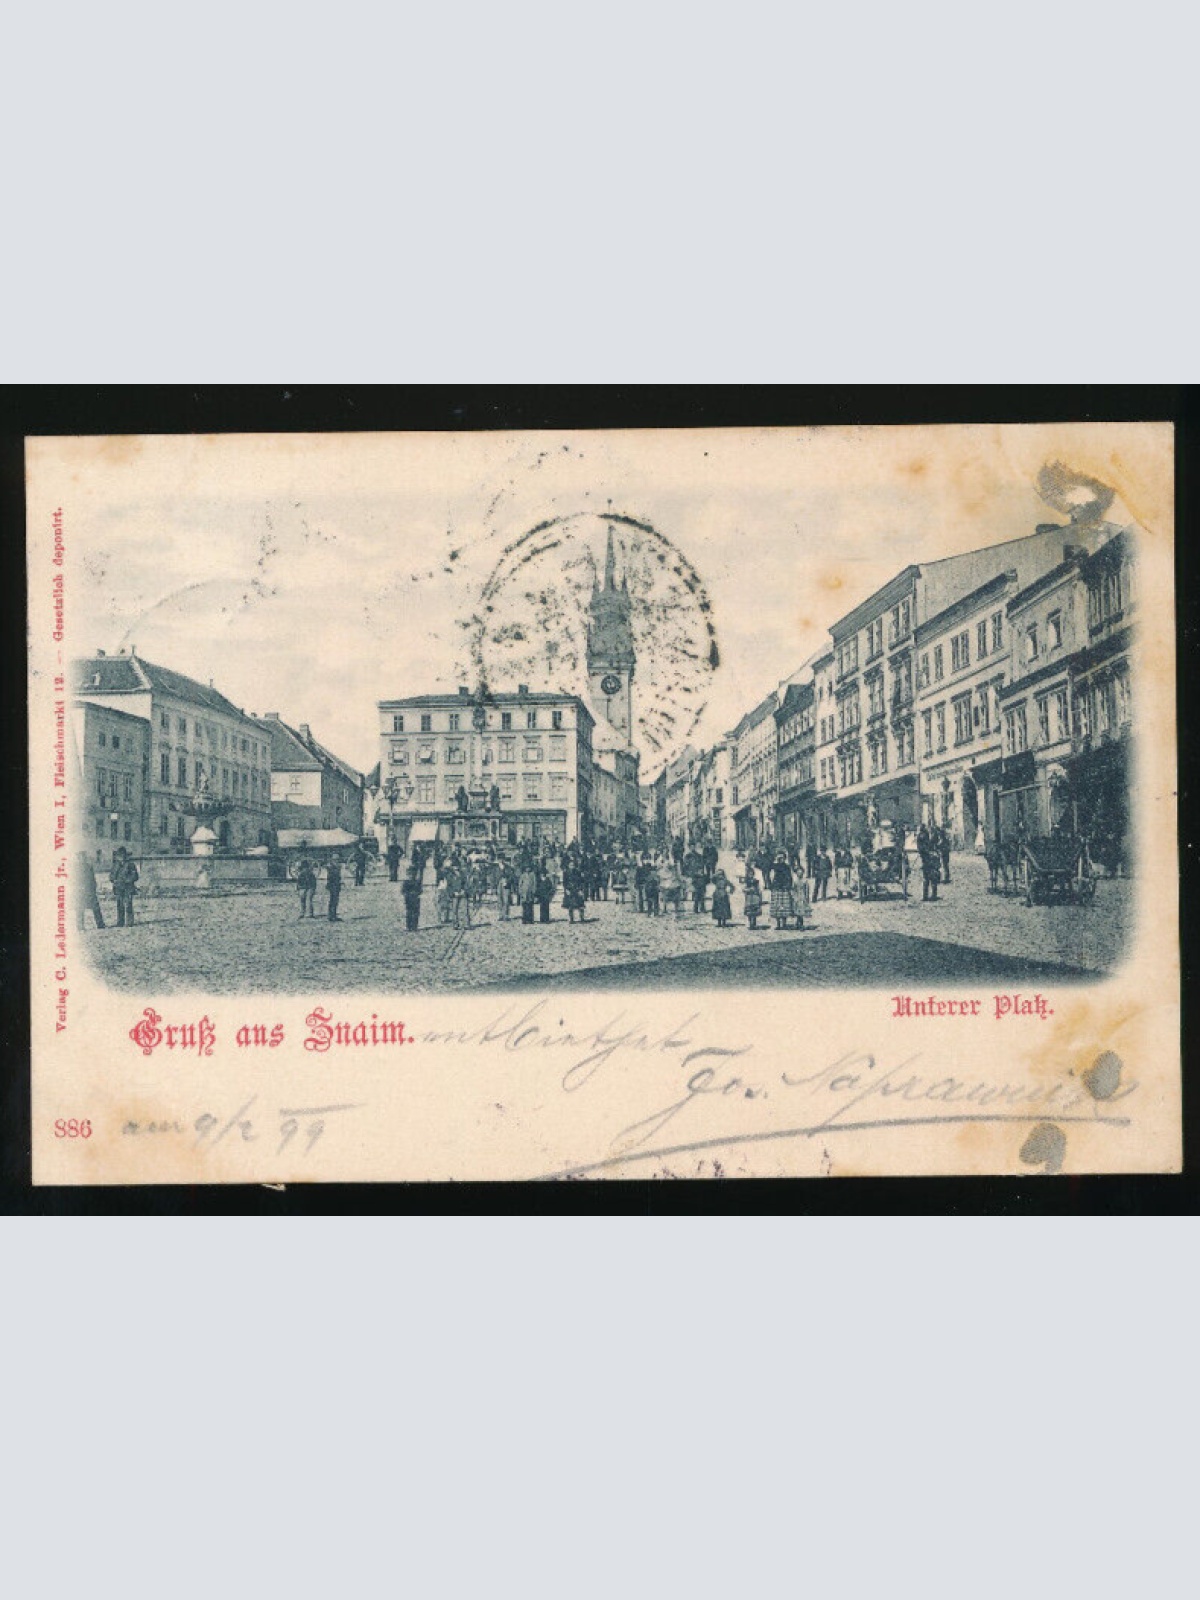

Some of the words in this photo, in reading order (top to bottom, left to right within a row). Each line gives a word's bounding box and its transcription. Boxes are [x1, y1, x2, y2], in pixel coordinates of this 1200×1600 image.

[52, 507, 66, 567] deponirt.
[52, 574, 65, 641] Gesetzlich
[54, 673, 66, 692] 12.
[53, 700, 66, 788] Fleischmarkt
[54, 815, 66, 850] Wien
[55, 886, 67, 958] Ledermann
[55, 967, 67, 981] C.
[56, 988, 69, 1033] Verlag
[892, 996, 981, 1018] Unterer
[994, 995, 1055, 1021] Platz.
[129, 1008, 217, 1056] Gruß
[235, 1023, 285, 1048] aus
[304, 1008, 415, 1056] Snaim.
[54, 1119, 93, 1139] 886
